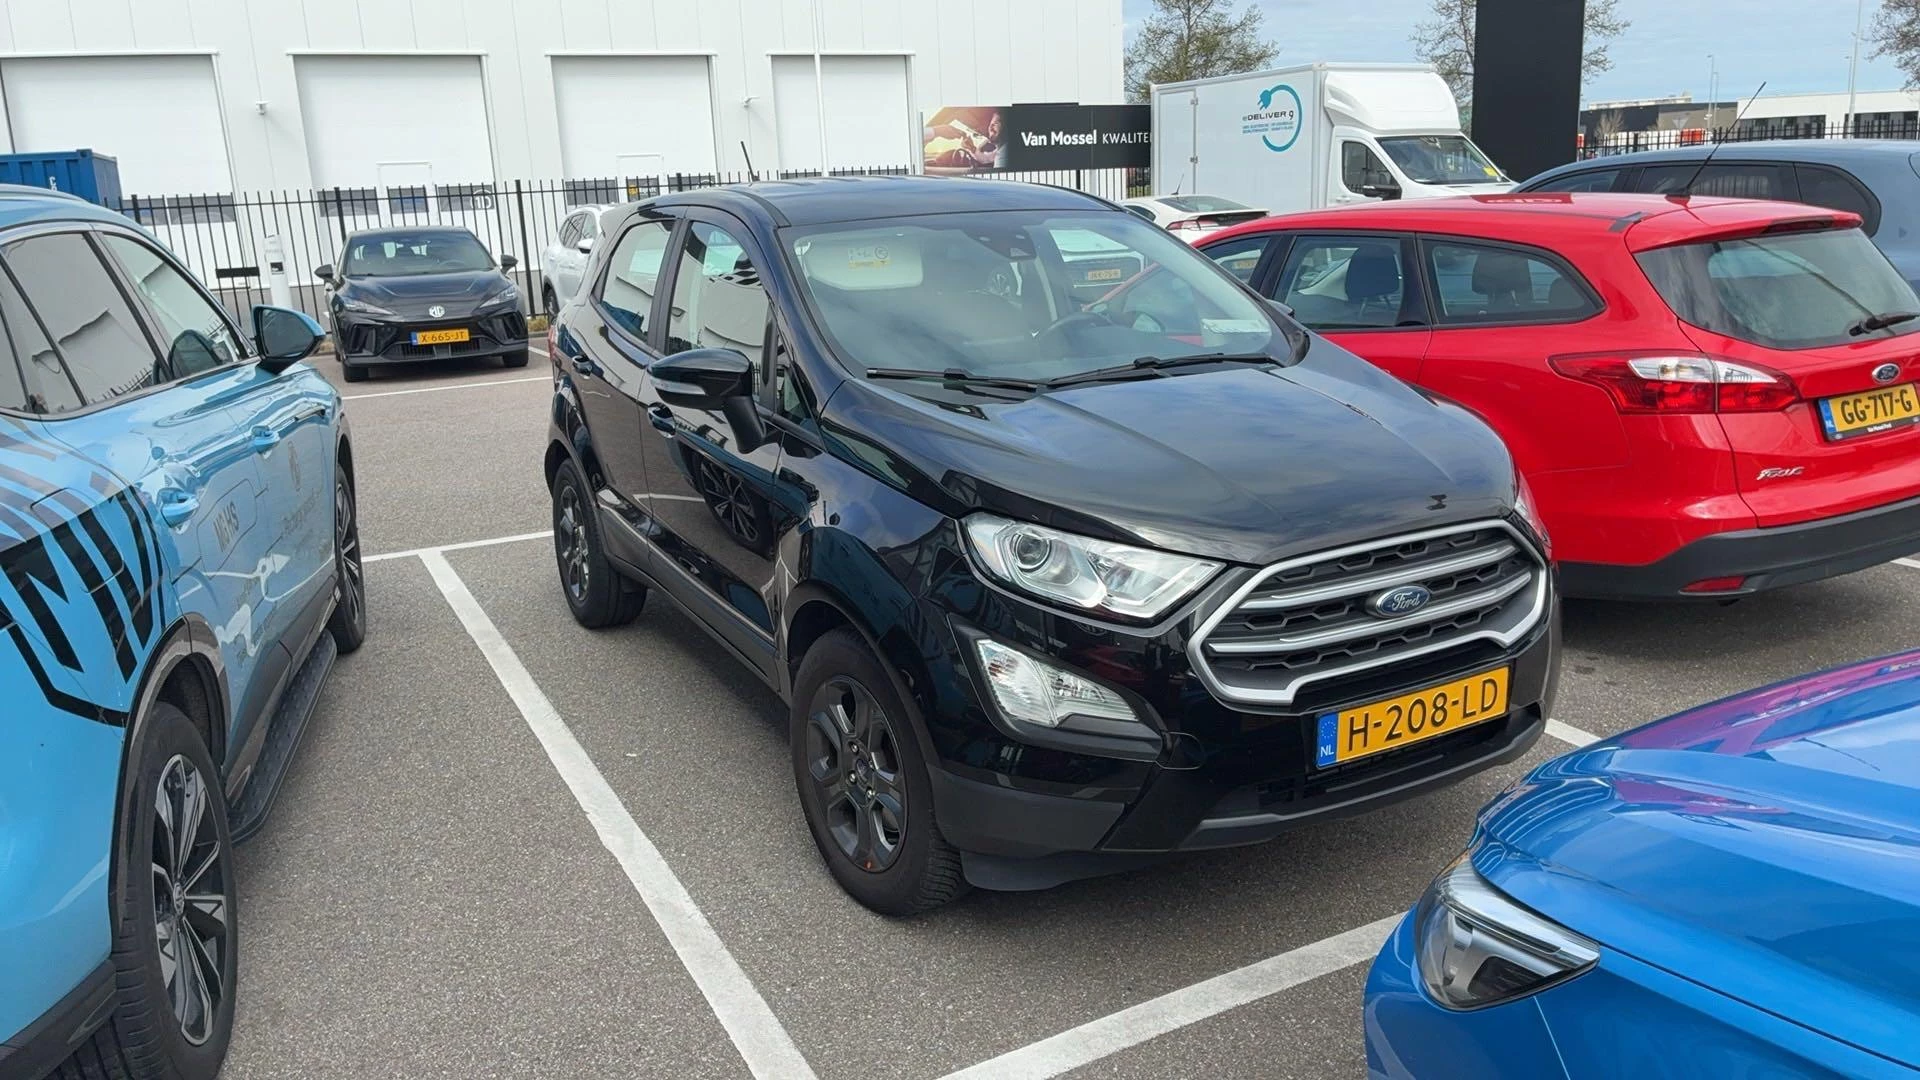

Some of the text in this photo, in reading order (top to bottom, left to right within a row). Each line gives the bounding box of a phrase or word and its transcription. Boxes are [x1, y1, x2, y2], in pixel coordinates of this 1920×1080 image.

[1021, 132, 1047, 146] Van
[1050, 129, 1097, 146] Mossel
[421, 332, 465, 343] X-665-JT
[1840, 389, 1912, 425] GG-717-G
[1391, 592, 1420, 611] Ford
[1348, 677, 1499, 752] H-208-LD
[1320, 744, 1334, 758] NL
